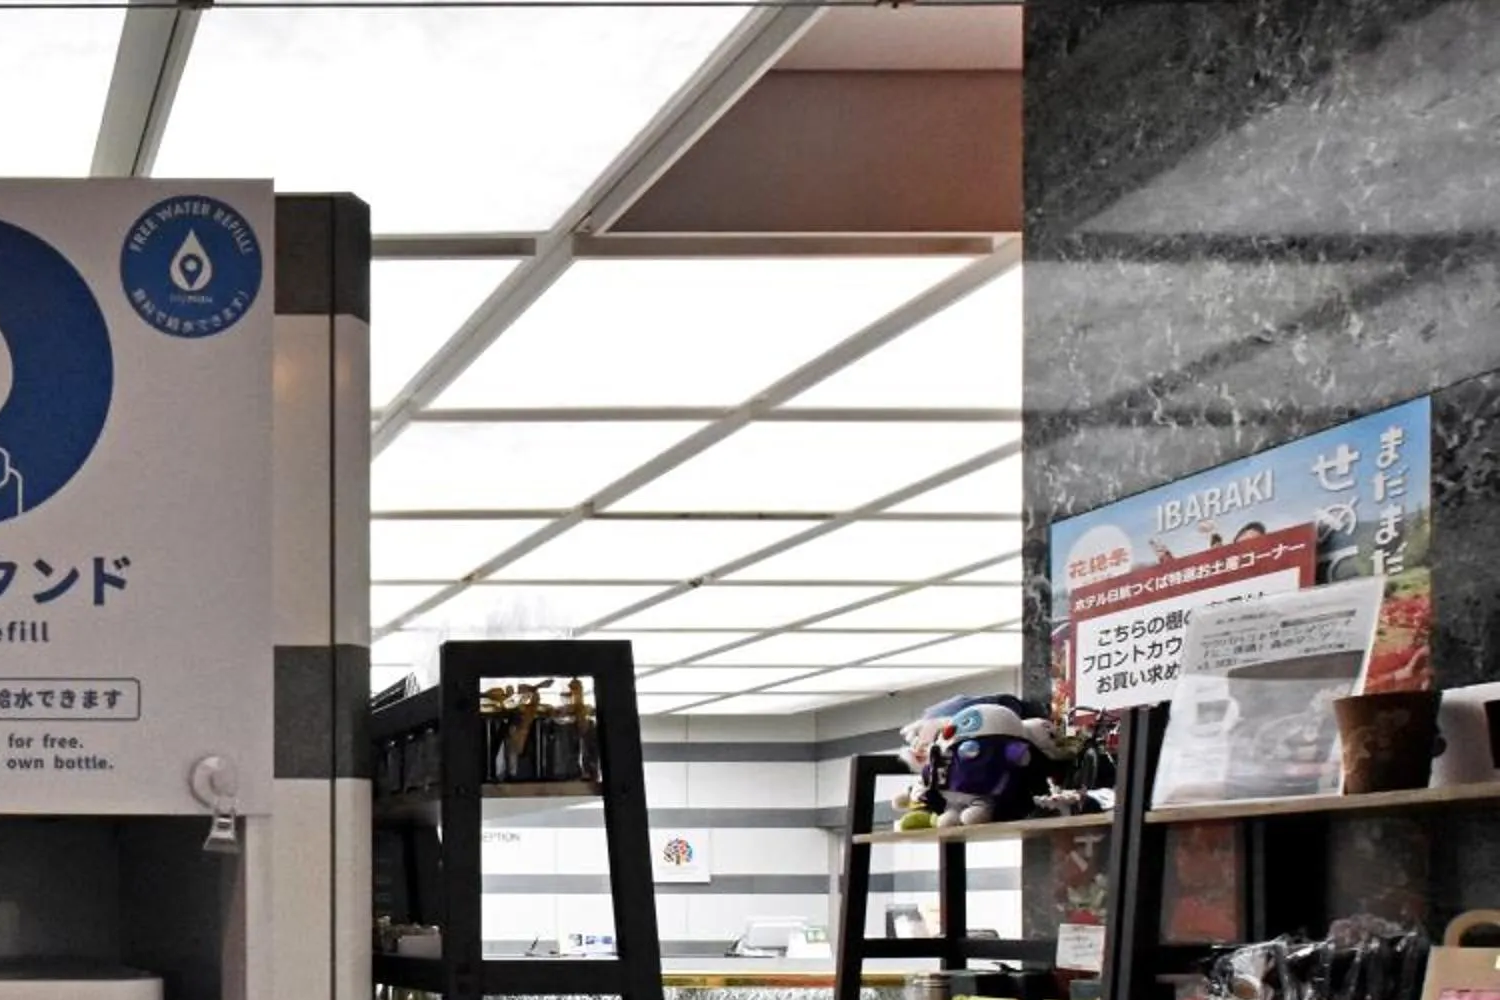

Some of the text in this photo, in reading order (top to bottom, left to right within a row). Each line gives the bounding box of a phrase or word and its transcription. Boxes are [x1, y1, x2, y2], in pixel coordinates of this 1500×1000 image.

[1157, 470, 1274, 532] IBARAKI
[1370, 424, 1410, 577] まだまだ
[8, 733, 33, 748] for
[43, 733, 83, 748] free.
[6, 758, 44, 770] own
[54, 755, 114, 769] bottle.
